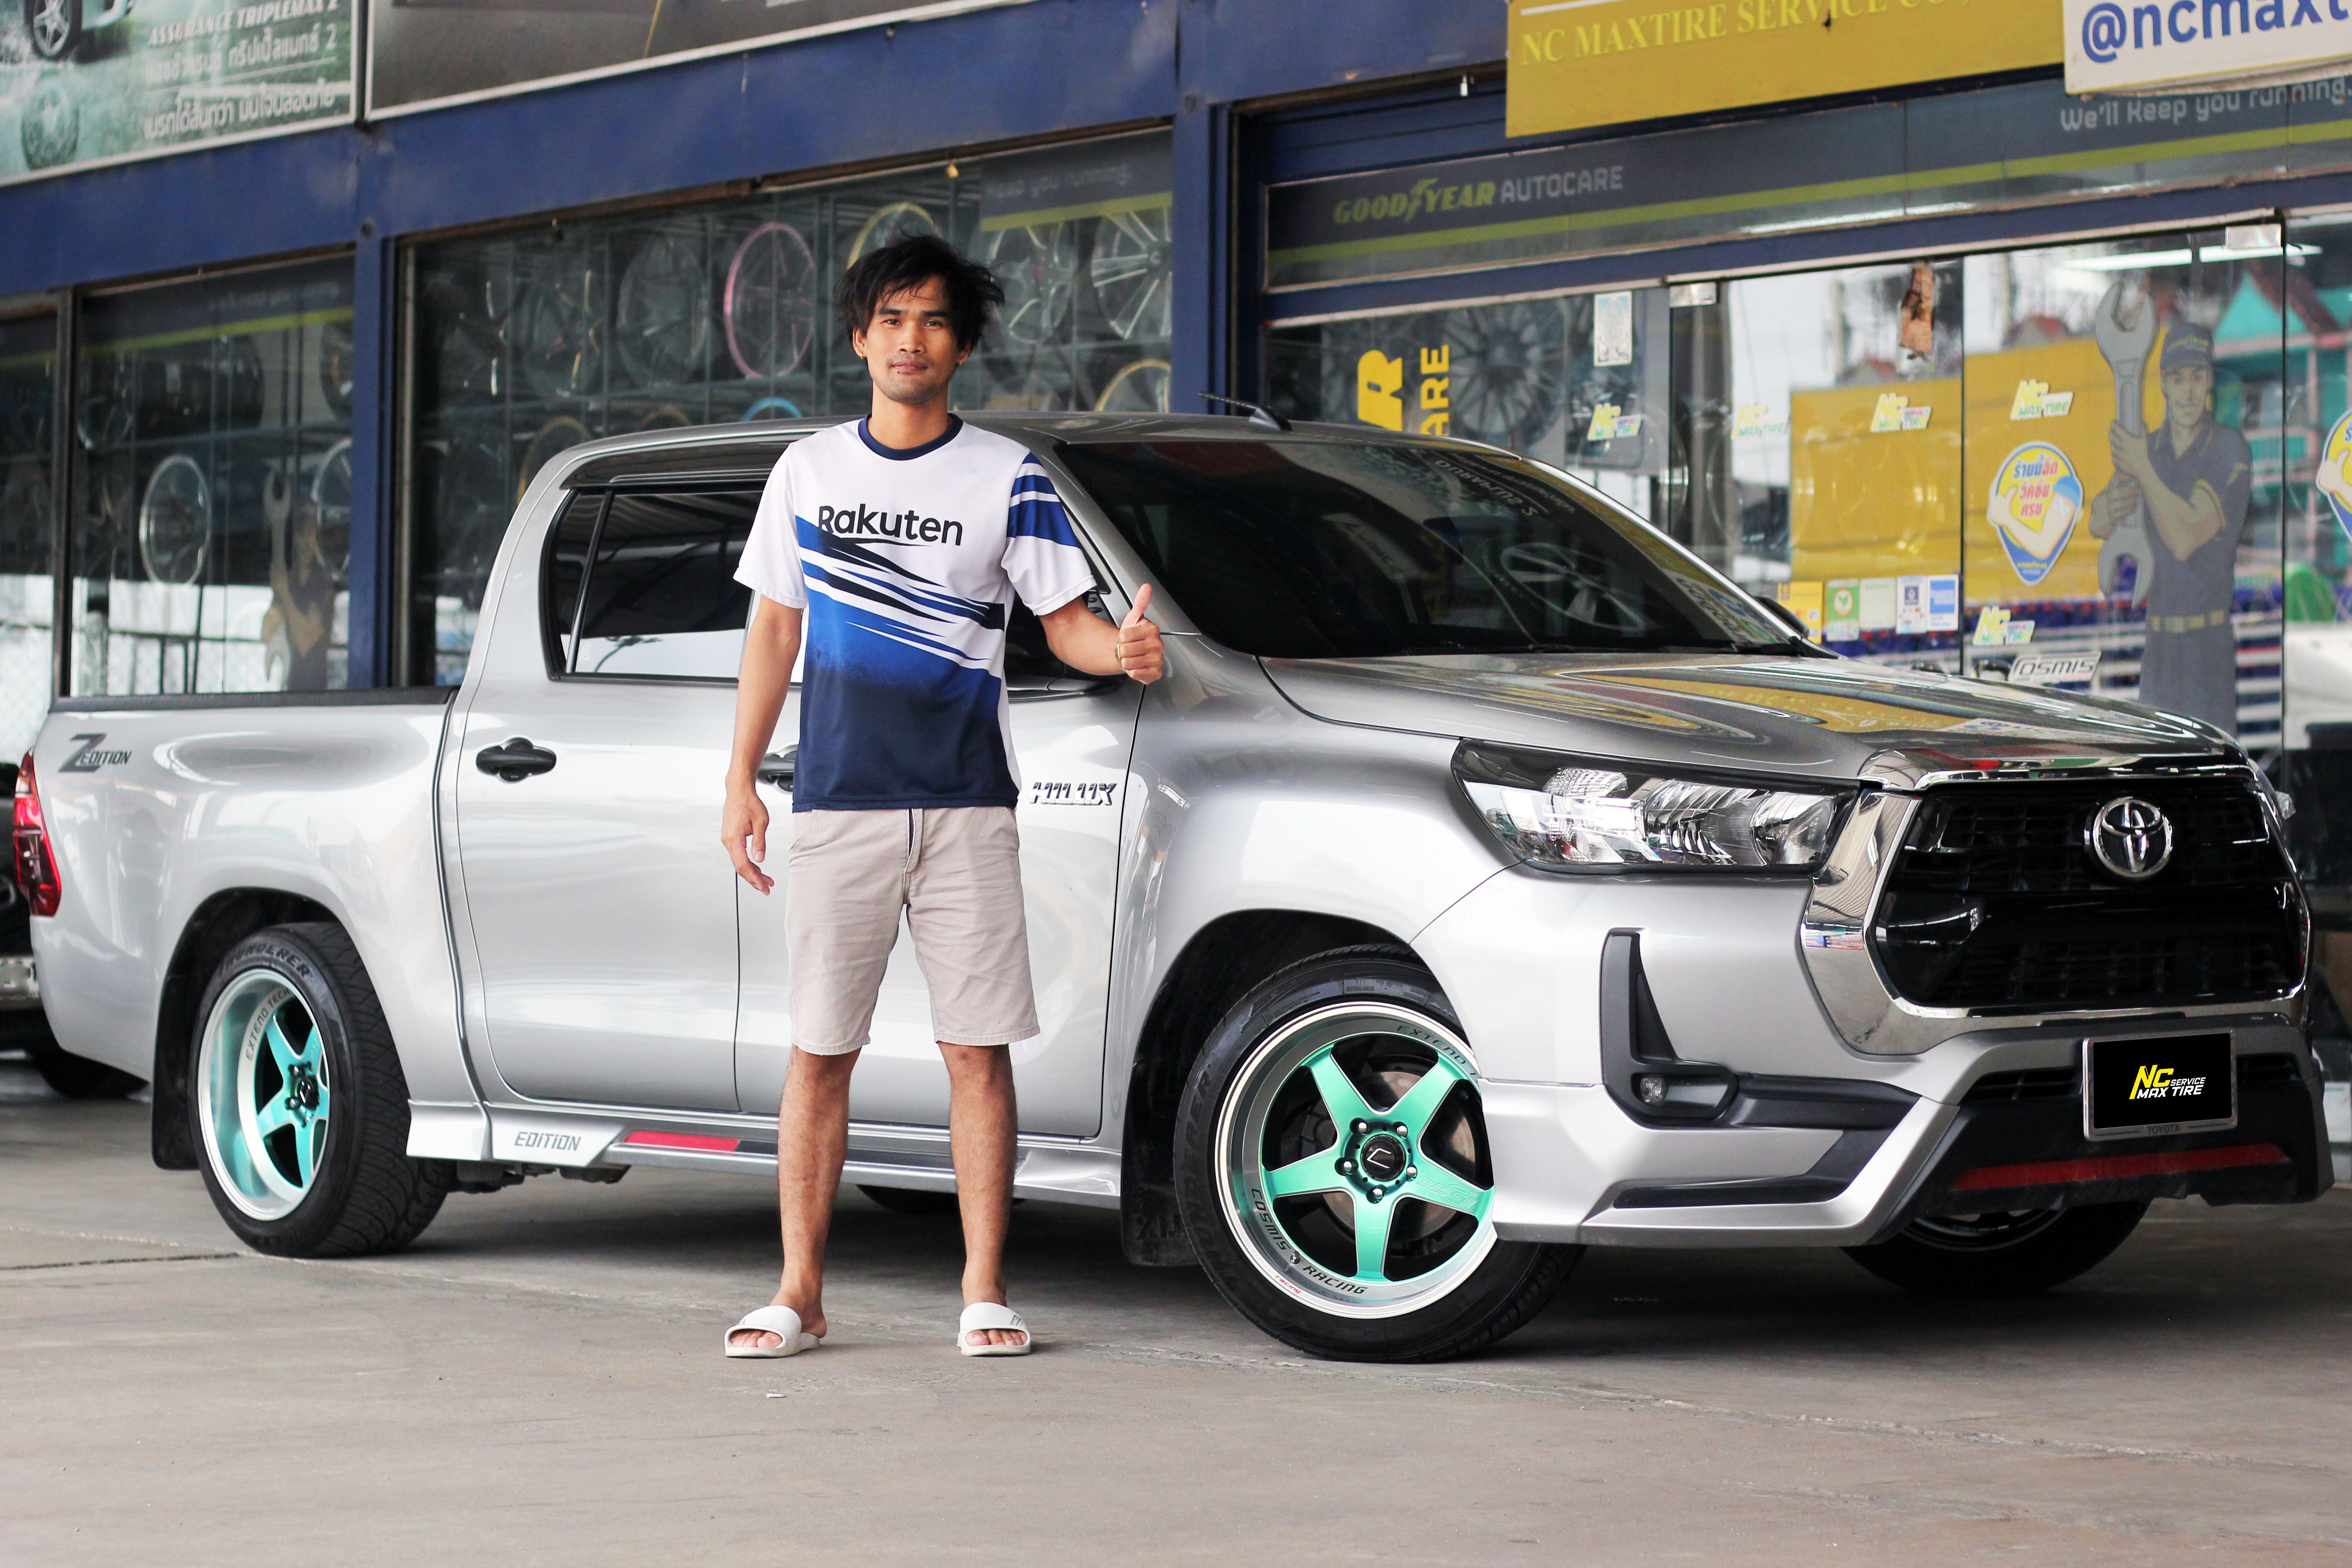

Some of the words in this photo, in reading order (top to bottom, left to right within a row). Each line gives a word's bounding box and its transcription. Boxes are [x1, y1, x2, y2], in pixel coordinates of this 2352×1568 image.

[148, 11, 232, 46] ASSURANCE
[325, 23, 338, 50] 2
[1521, 29, 1565, 65] NC
[1574, 4, 1728, 59] MAXTIRE
[2060, 101, 2119, 132] We'll
[2195, 91, 2240, 121] you
[1333, 177, 1496, 224] GOODYEAR
[1499, 166, 1623, 204] AUTOCARE
[1872, 395, 1906, 429] NC
[2012, 382, 2048, 416] NC
[1588, 405, 1620, 437] NC
[818, 503, 963, 546] Rakuten
[1975, 608, 2009, 643] NC
[58, 733, 108, 773] Z
[80, 750, 132, 764] EDITION
[1029, 782, 1117, 806] HILUX
[1396, 1025, 1466, 1064] EXTEND
[514, 1131, 581, 1152] EDITION
[2147, 1124, 2181, 1135] TOYOTA
[1251, 1188, 1291, 1250] COSMIS
[1302, 1265, 1368, 1294] RACING
[1275, 1275, 1302, 1294] racing
